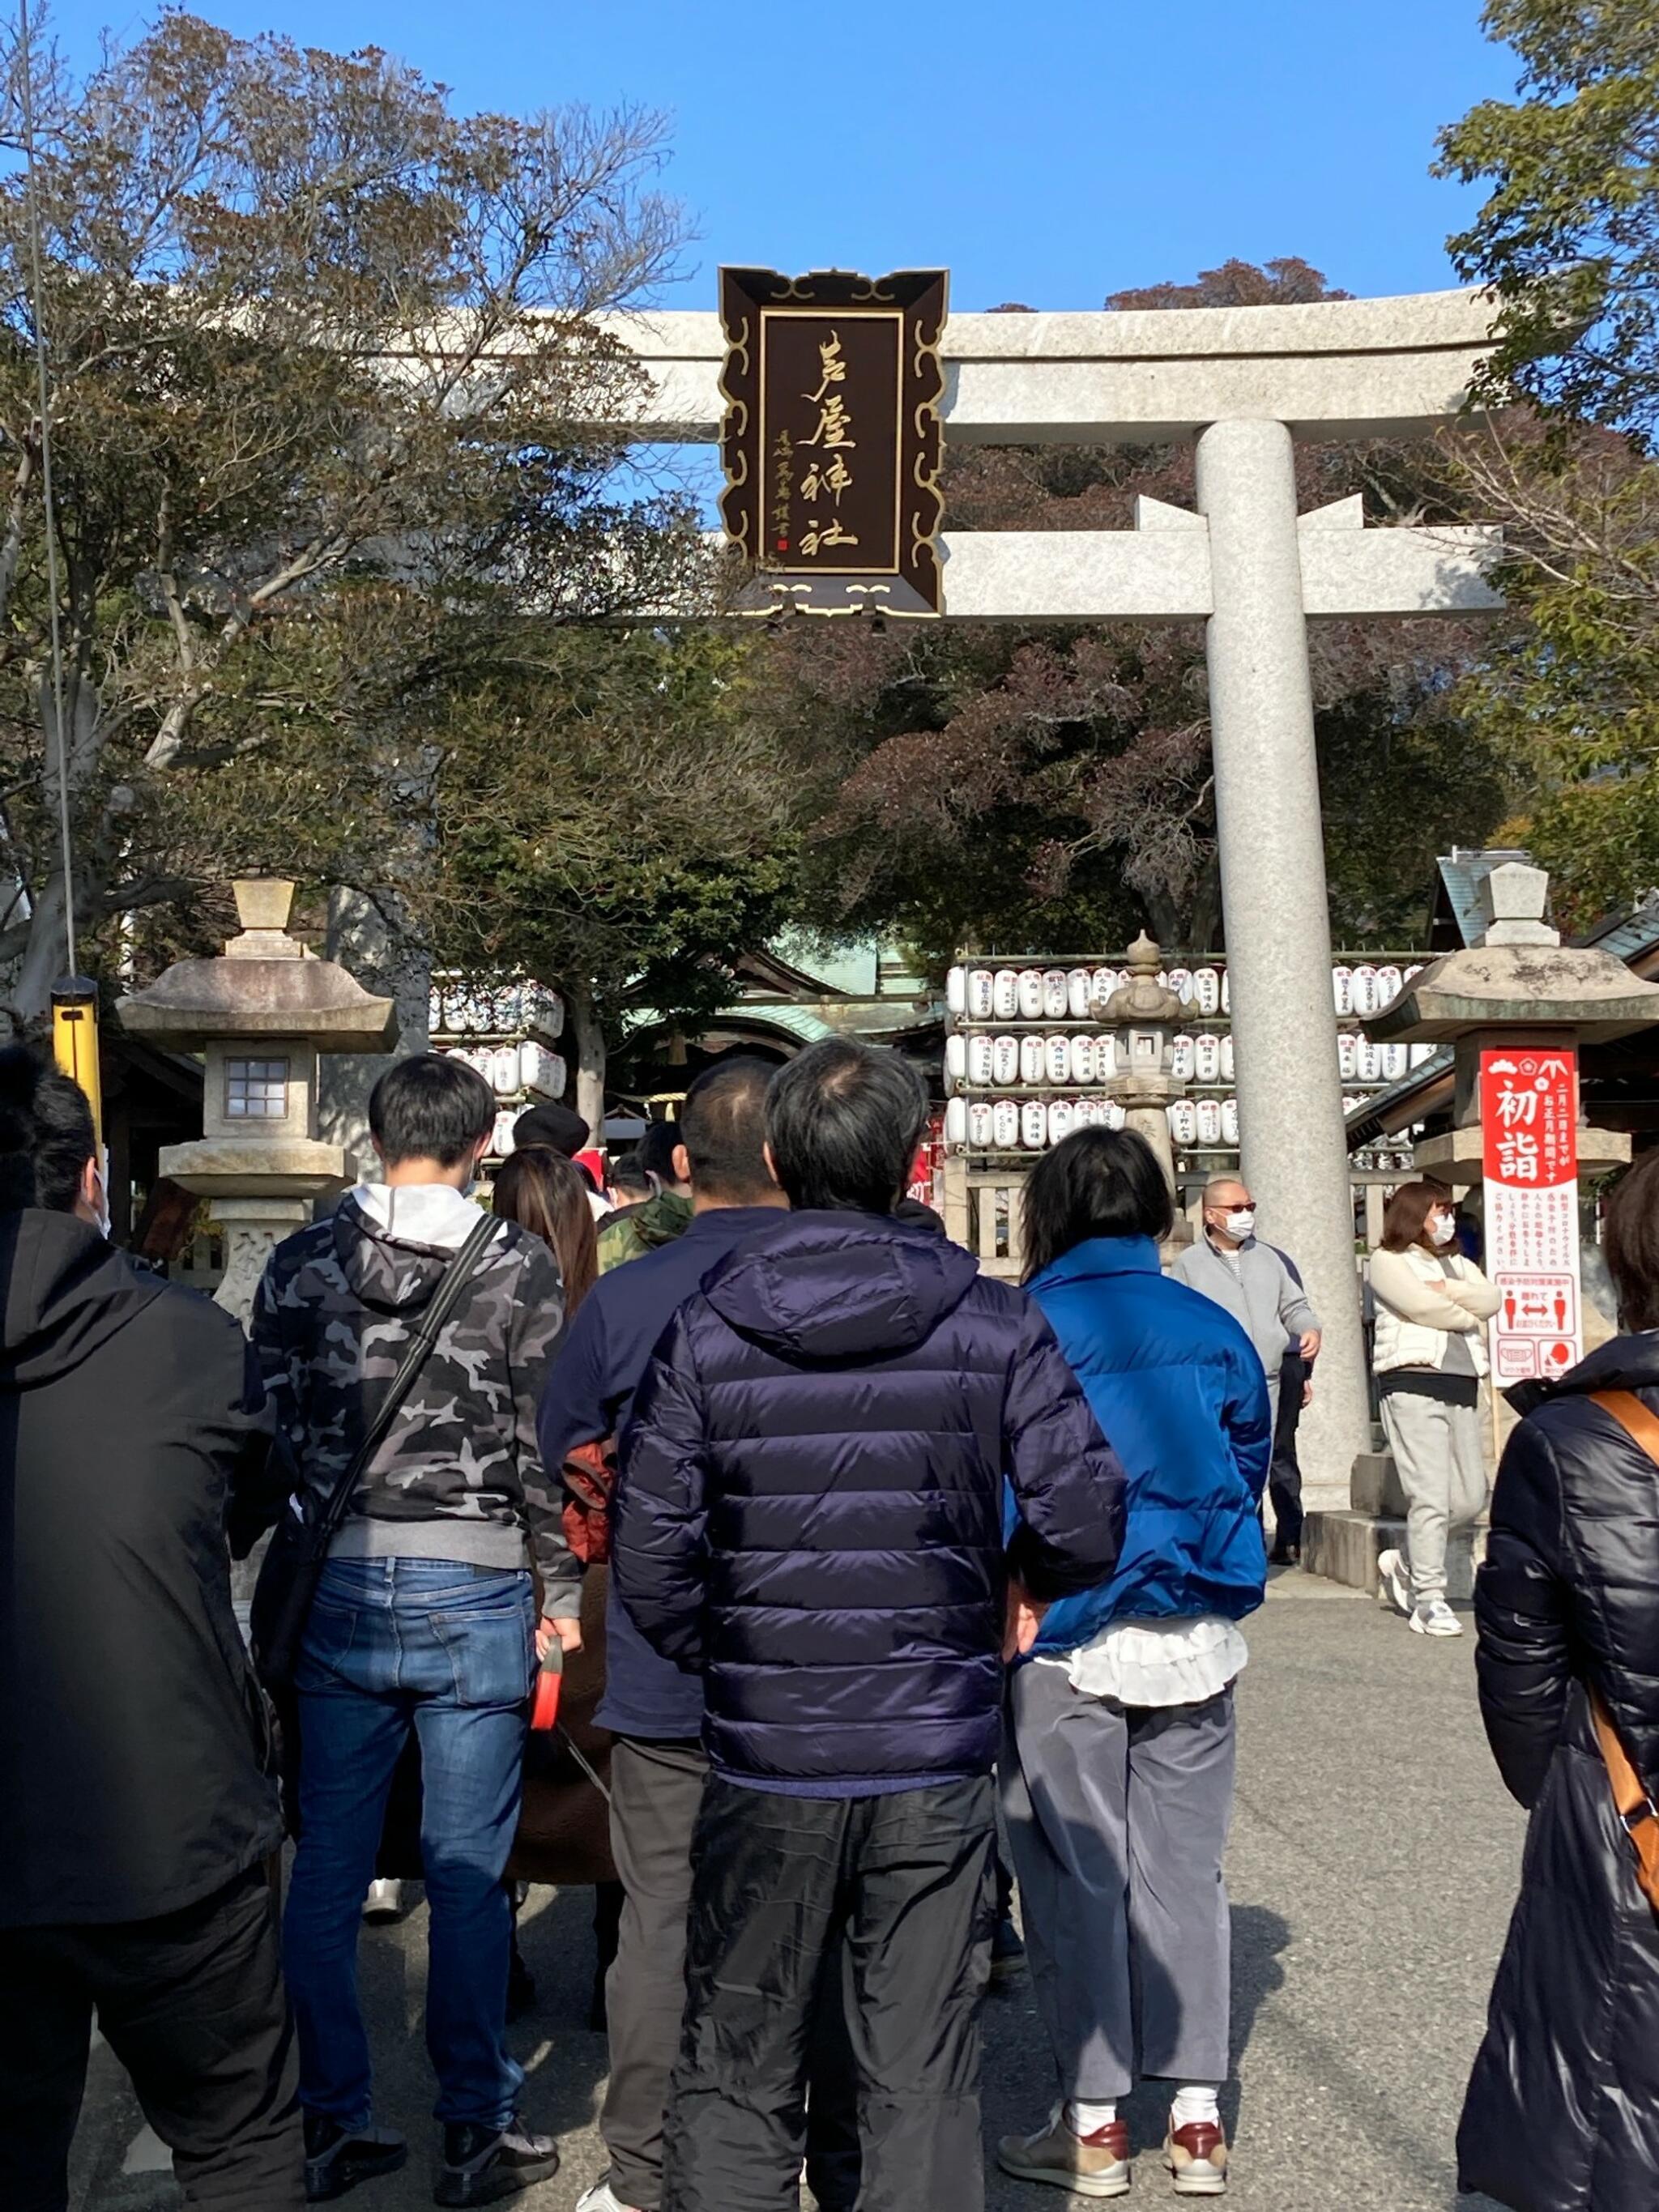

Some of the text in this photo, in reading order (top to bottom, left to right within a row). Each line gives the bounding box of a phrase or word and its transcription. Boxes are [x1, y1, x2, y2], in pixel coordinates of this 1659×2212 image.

[1495, 1080, 1539, 1182] 初詣
[1542, 1095, 1557, 1183] お正月期間です
